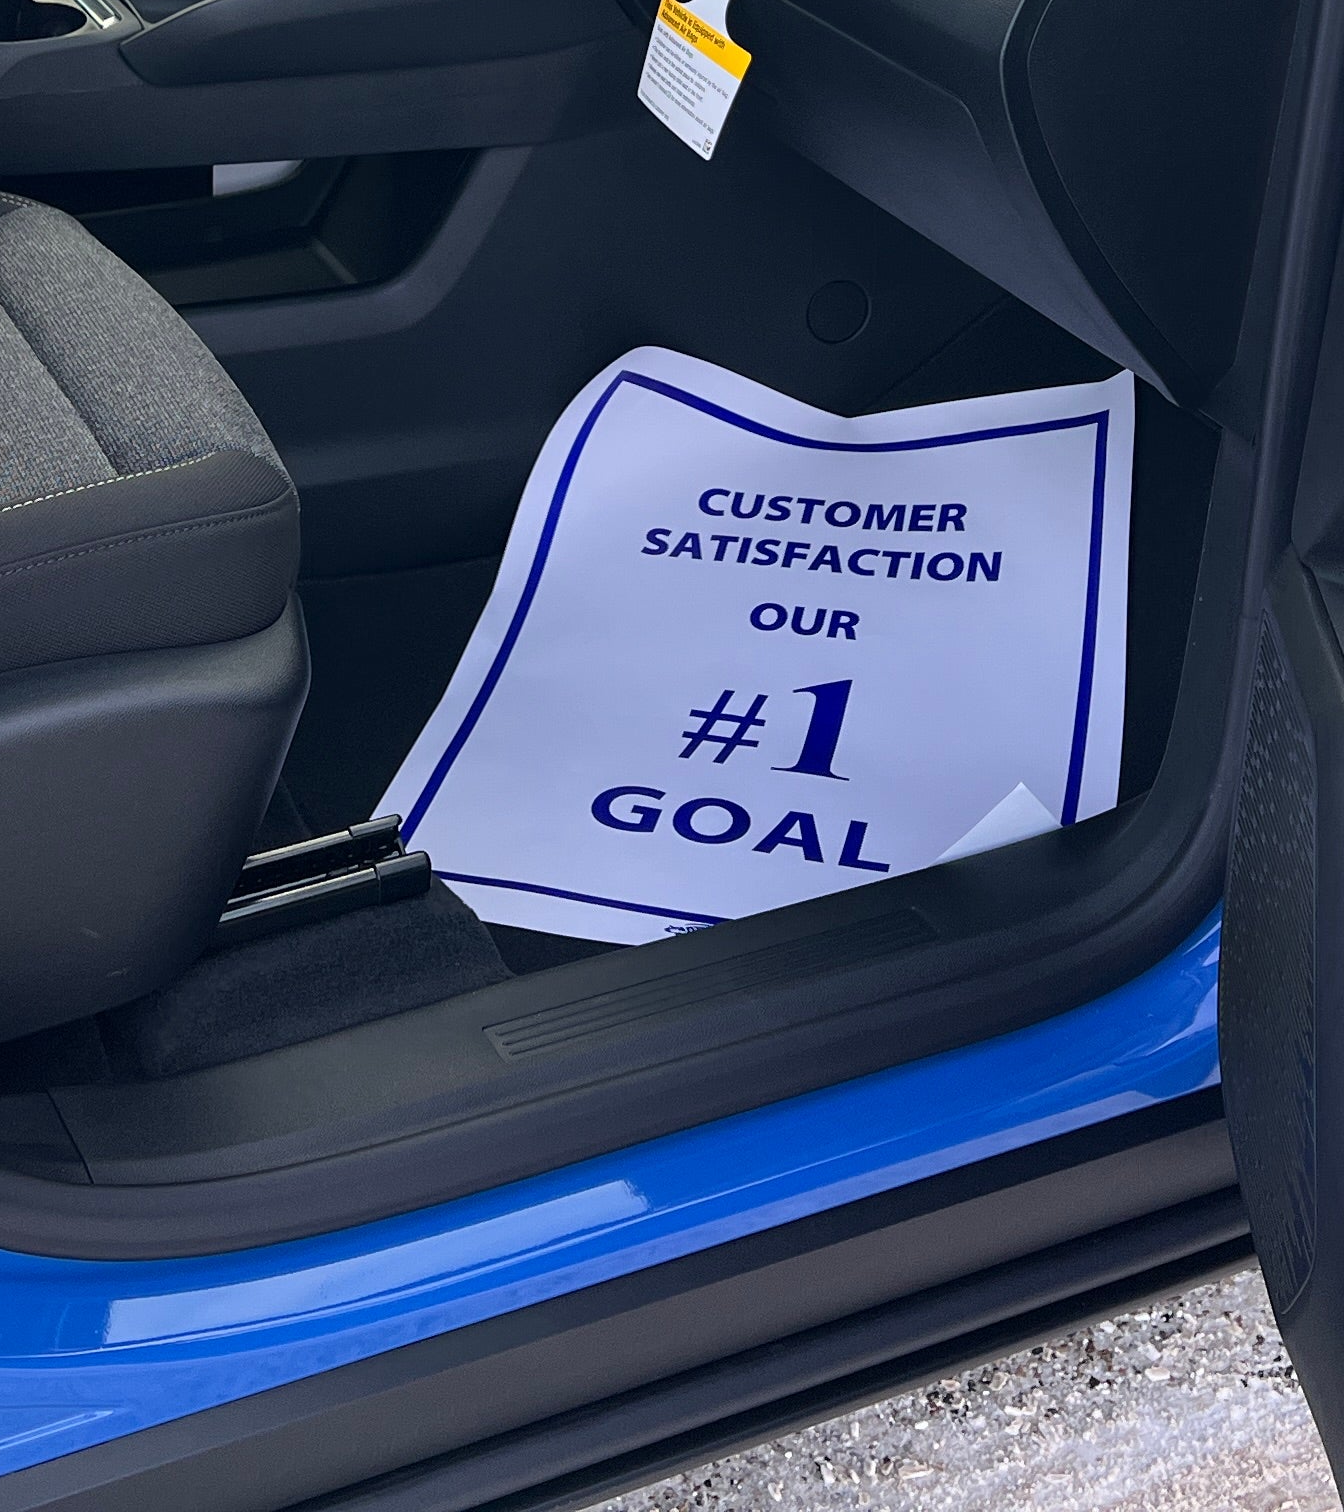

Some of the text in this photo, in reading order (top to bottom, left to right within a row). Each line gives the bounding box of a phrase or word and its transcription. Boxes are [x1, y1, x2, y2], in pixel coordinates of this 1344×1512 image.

[698, 488, 968, 533] CUSTOMER
[640, 527, 1003, 583] SATISFACTION
[749, 602, 861, 641] OUR
[678, 679, 854, 782] #1
[591, 785, 892, 874] GOAL
